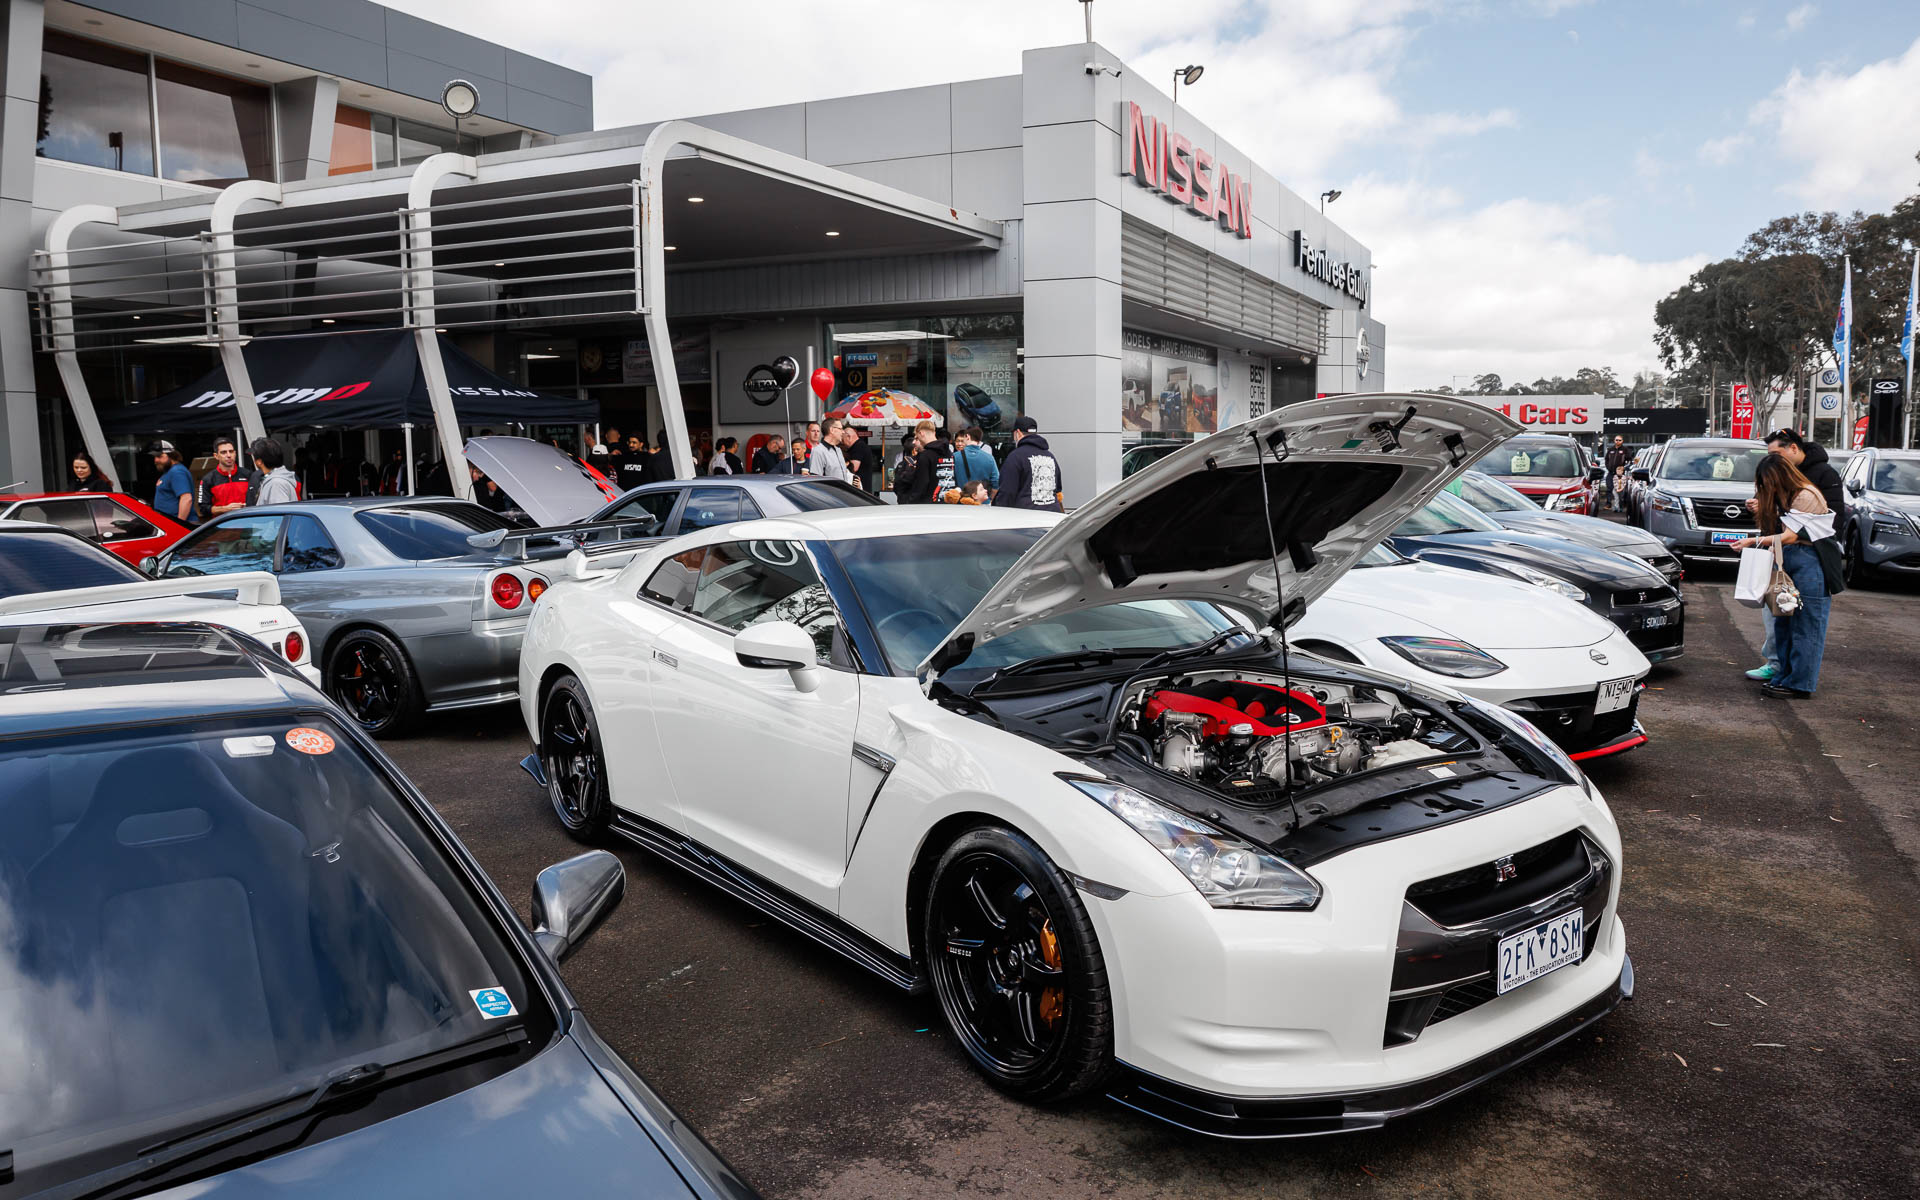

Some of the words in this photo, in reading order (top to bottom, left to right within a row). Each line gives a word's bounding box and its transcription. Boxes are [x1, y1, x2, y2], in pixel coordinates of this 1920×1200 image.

[1126, 100, 1252, 239] NISSAN
[1296, 230, 1346, 290] Ferntree
[1346, 262, 1369, 310] Gully
[1161, 339, 1179, 355] HAVE
[1180, 344, 1208, 361] ARRIVED!
[1250, 365, 1265, 385] BEST
[447, 387, 539, 398] ISSAN
[1250, 401, 1265, 419] BEST
[1519, 403, 1588, 425] Cars
[1605, 681, 1633, 698] NISMO
[1612, 696, 1620, 711] Z
[302, 737, 320, 746] 30
[1503, 936, 1536, 981] 2FK
[1550, 917, 1581, 959] 8SM
[1503, 974, 1526, 990] VICTORIA
[1529, 967, 1539, 977] THE
[1539, 956, 1565, 974] EDUCATION
[1565, 950, 1578, 963] STATE
